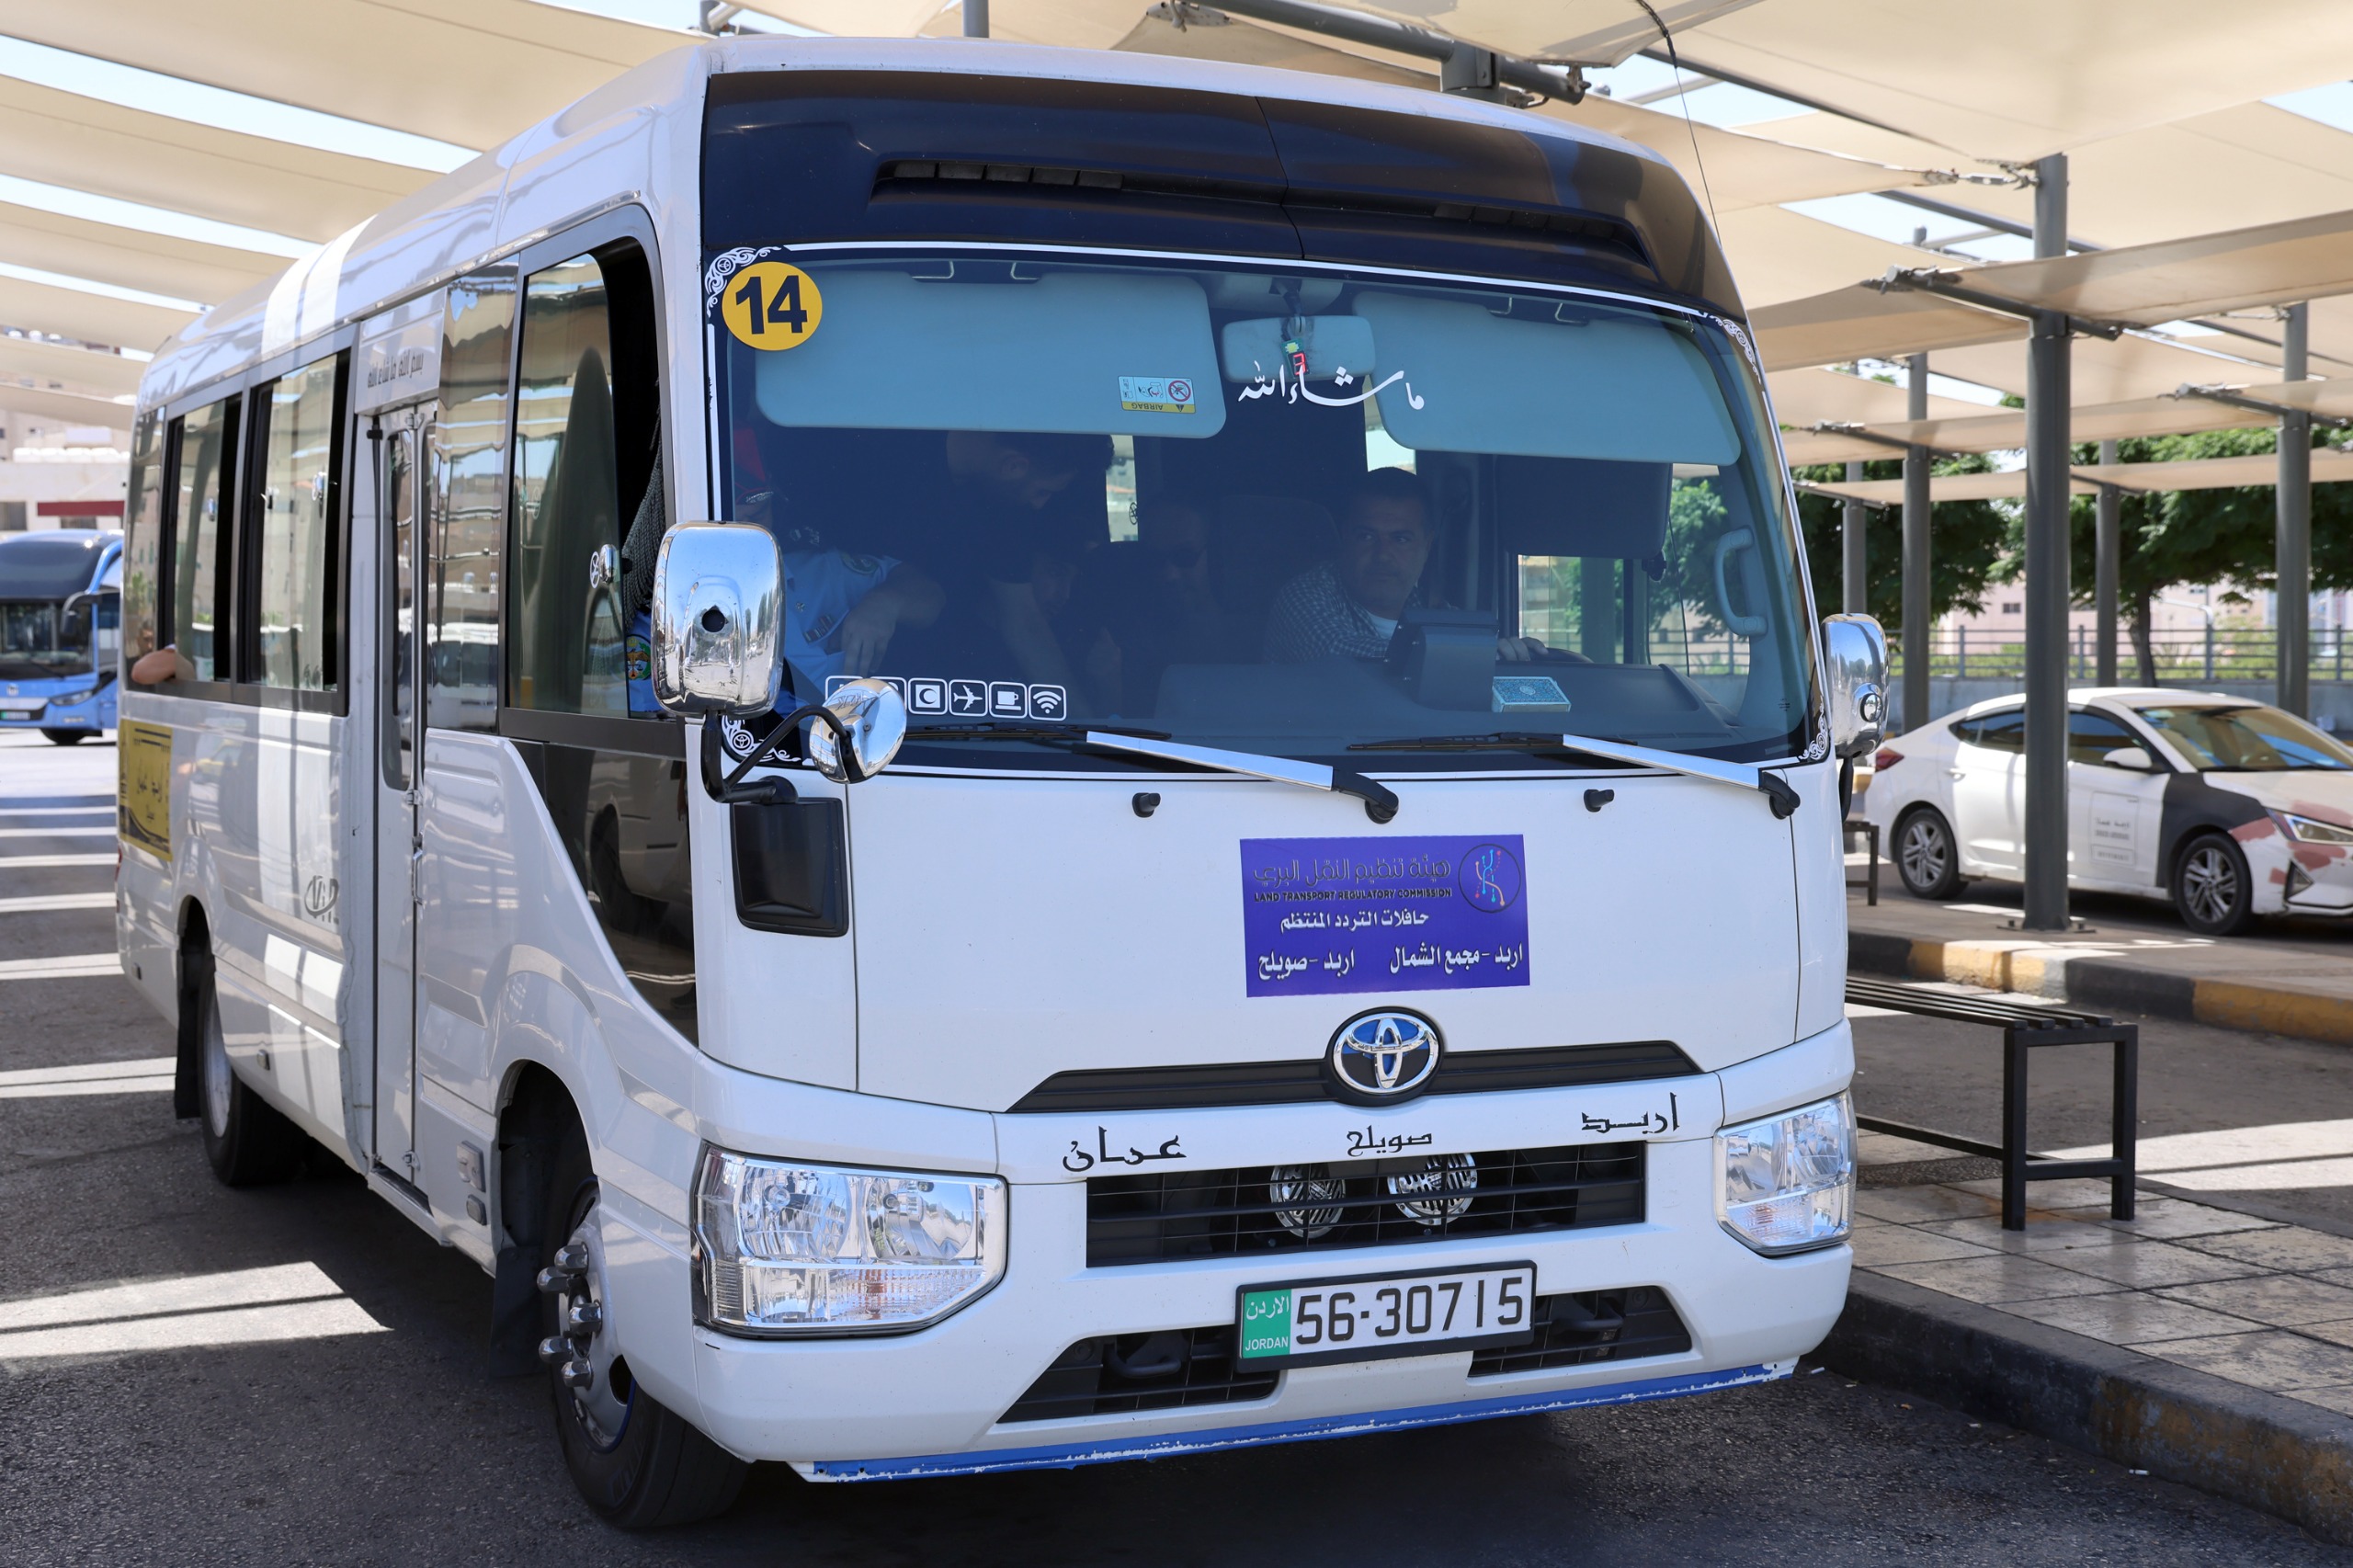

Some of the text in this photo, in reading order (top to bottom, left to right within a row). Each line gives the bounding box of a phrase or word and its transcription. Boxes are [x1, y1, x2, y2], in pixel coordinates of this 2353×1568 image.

[735, 275, 808, 335] 14
[1238, 359, 1425, 410] ما شاء الله
[1253, 854, 1451, 888] هيئة تنظيم النقل البري
[1254, 887, 1452, 903] LAND TRANSPORT REGULATORY COMMISSION
[1280, 907, 1429, 935] حافلات التردد المنتظم
[1390, 941, 1441, 974] الشمال
[1581, 1091, 1680, 1134] اربد
[1062, 1124, 1188, 1173] عمان
[1346, 1124, 1433, 1157] صويلح
[1245, 1294, 1290, 1321] الاردن
[1295, 1276, 1523, 1346] 56-30715
[1245, 1335, 1290, 1352] JORDAN
